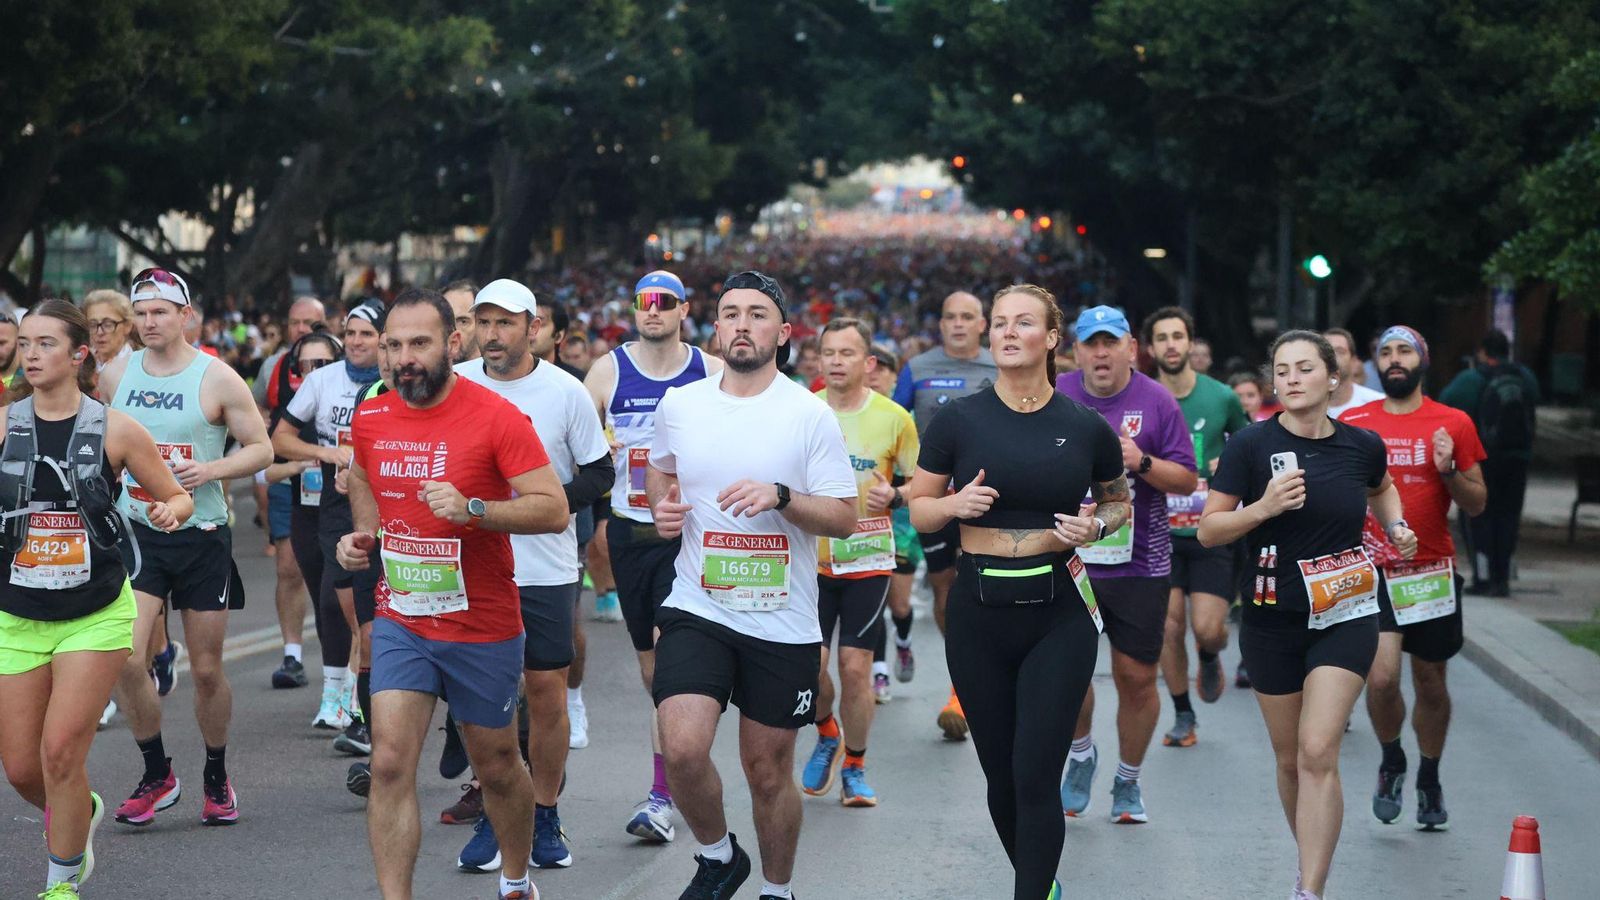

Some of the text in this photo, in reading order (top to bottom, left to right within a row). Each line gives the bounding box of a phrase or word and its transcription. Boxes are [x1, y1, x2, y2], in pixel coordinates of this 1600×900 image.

[126, 389, 184, 411] HOKA
[385, 440, 432, 452] GENERALI
[379, 459, 429, 478] MÁLAGA
[29, 516, 81, 528] GENERALI
[26, 539, 70, 555] 16429
[398, 541, 453, 556] GENERALI
[725, 536, 784, 549] GENERALI
[719, 560, 771, 576] 16679
[1315, 552, 1363, 572] GENERALI
[62, 570, 77, 578] 21K
[395, 565, 443, 583] 10205
[1321, 573, 1363, 597] 15552
[1401, 580, 1440, 597] 15564
